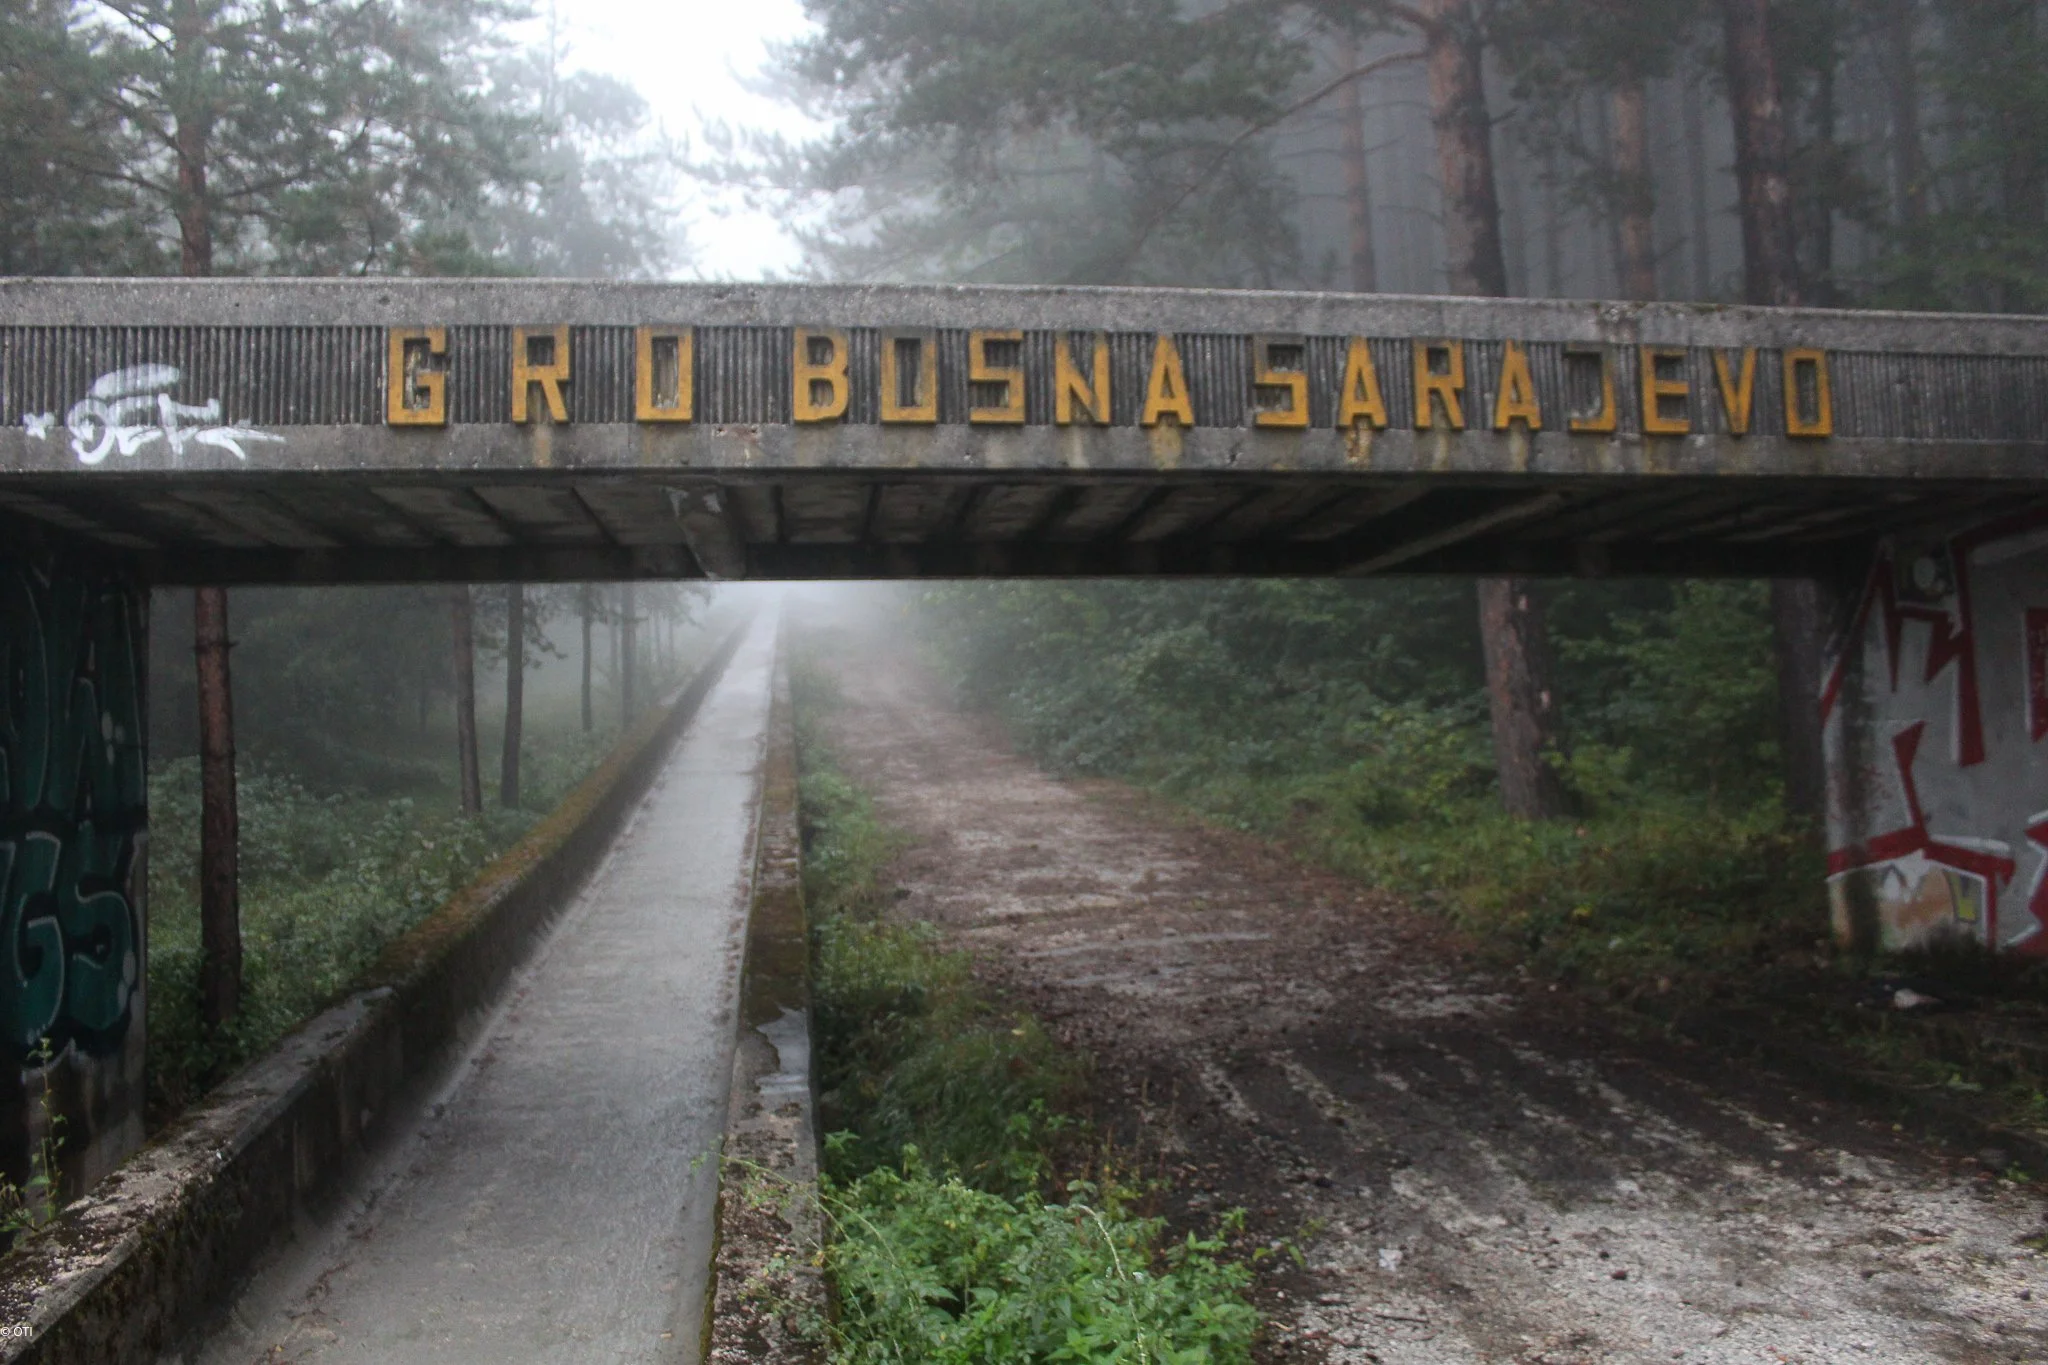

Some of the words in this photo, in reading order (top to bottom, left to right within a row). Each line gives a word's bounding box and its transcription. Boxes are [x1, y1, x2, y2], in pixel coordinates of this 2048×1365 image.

[388, 325, 693, 425] GRO
[793, 326, 1194, 426] BOSNA
[1252, 334, 1833, 437] SARAJEVO
